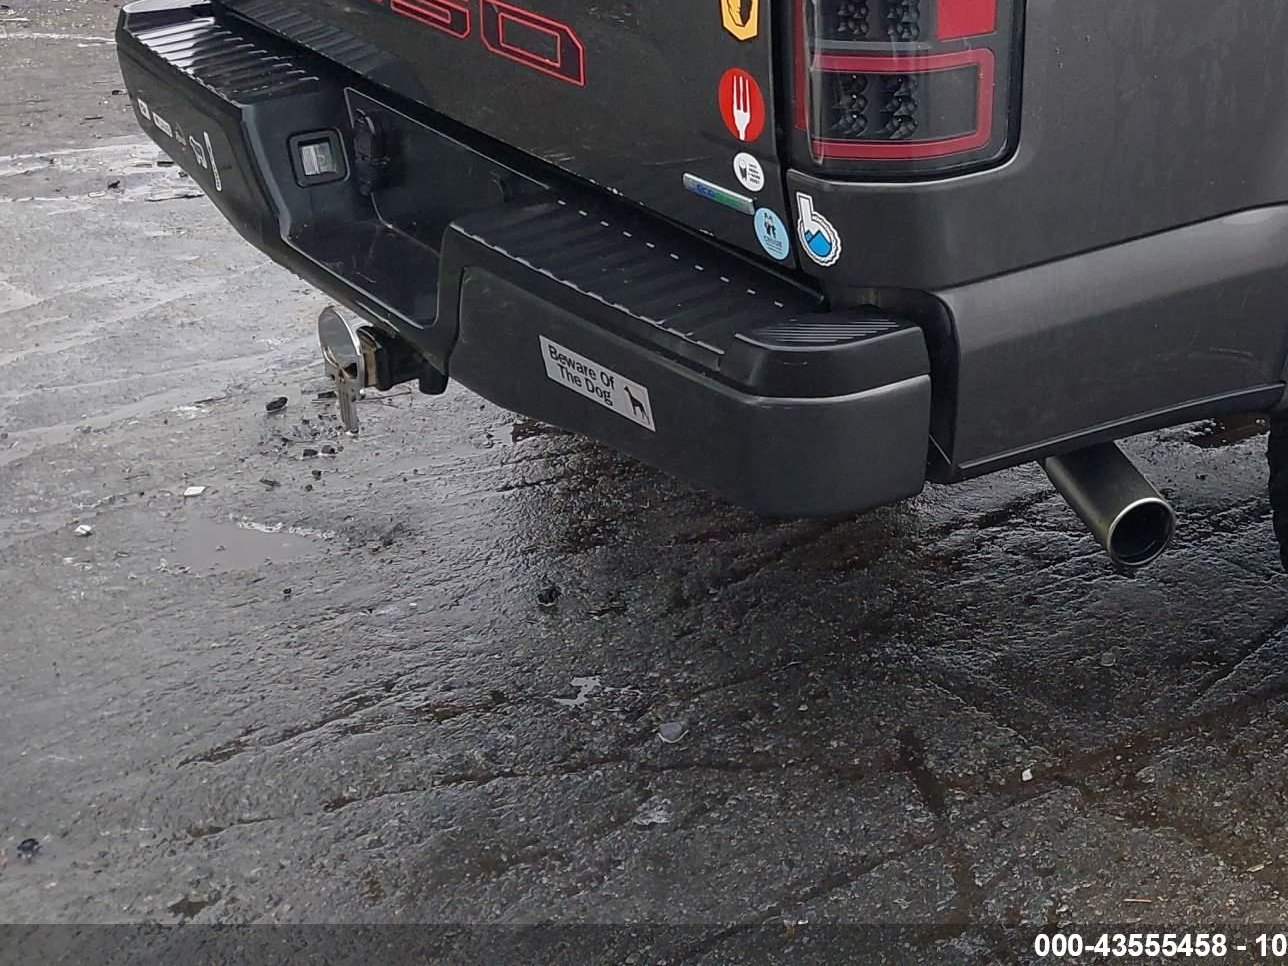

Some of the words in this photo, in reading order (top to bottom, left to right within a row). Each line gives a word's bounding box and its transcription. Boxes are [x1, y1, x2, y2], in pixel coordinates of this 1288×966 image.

[548, 344, 597, 381] Beware
[600, 371, 615, 390] Of
[557, 363, 582, 387] The
[585, 378, 613, 406] Dog
